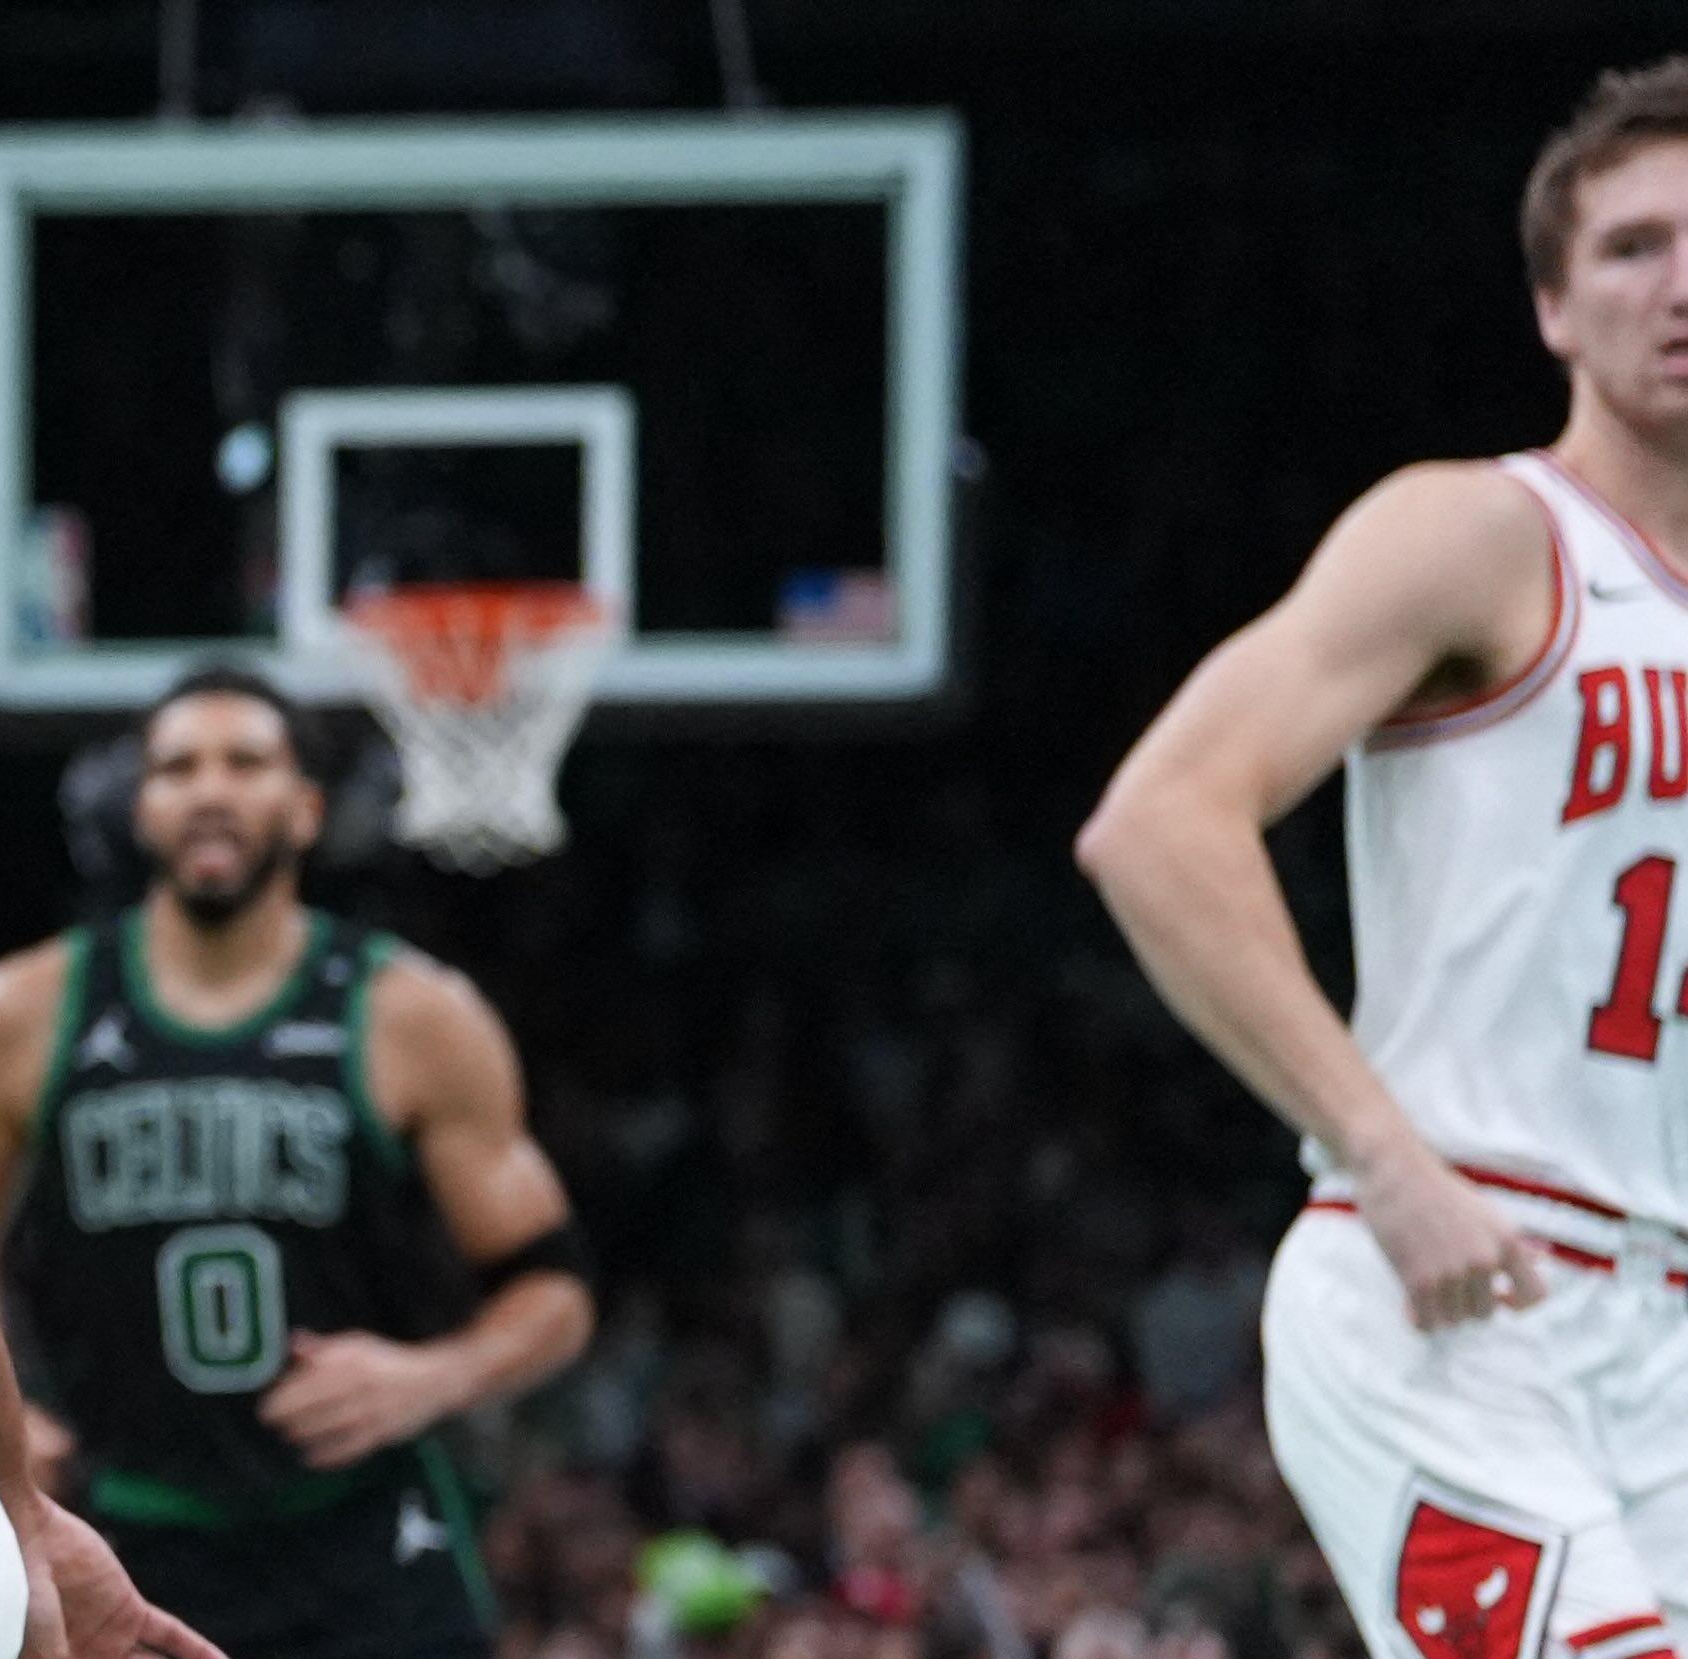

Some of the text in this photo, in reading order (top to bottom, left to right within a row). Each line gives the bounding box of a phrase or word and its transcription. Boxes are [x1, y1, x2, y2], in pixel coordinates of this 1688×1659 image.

[1561, 665, 1688, 826] BU
[1586, 855, 1688, 1064] 1
[61, 1078, 347, 1233] CELTICS
[156, 1226, 287, 1393] 0
